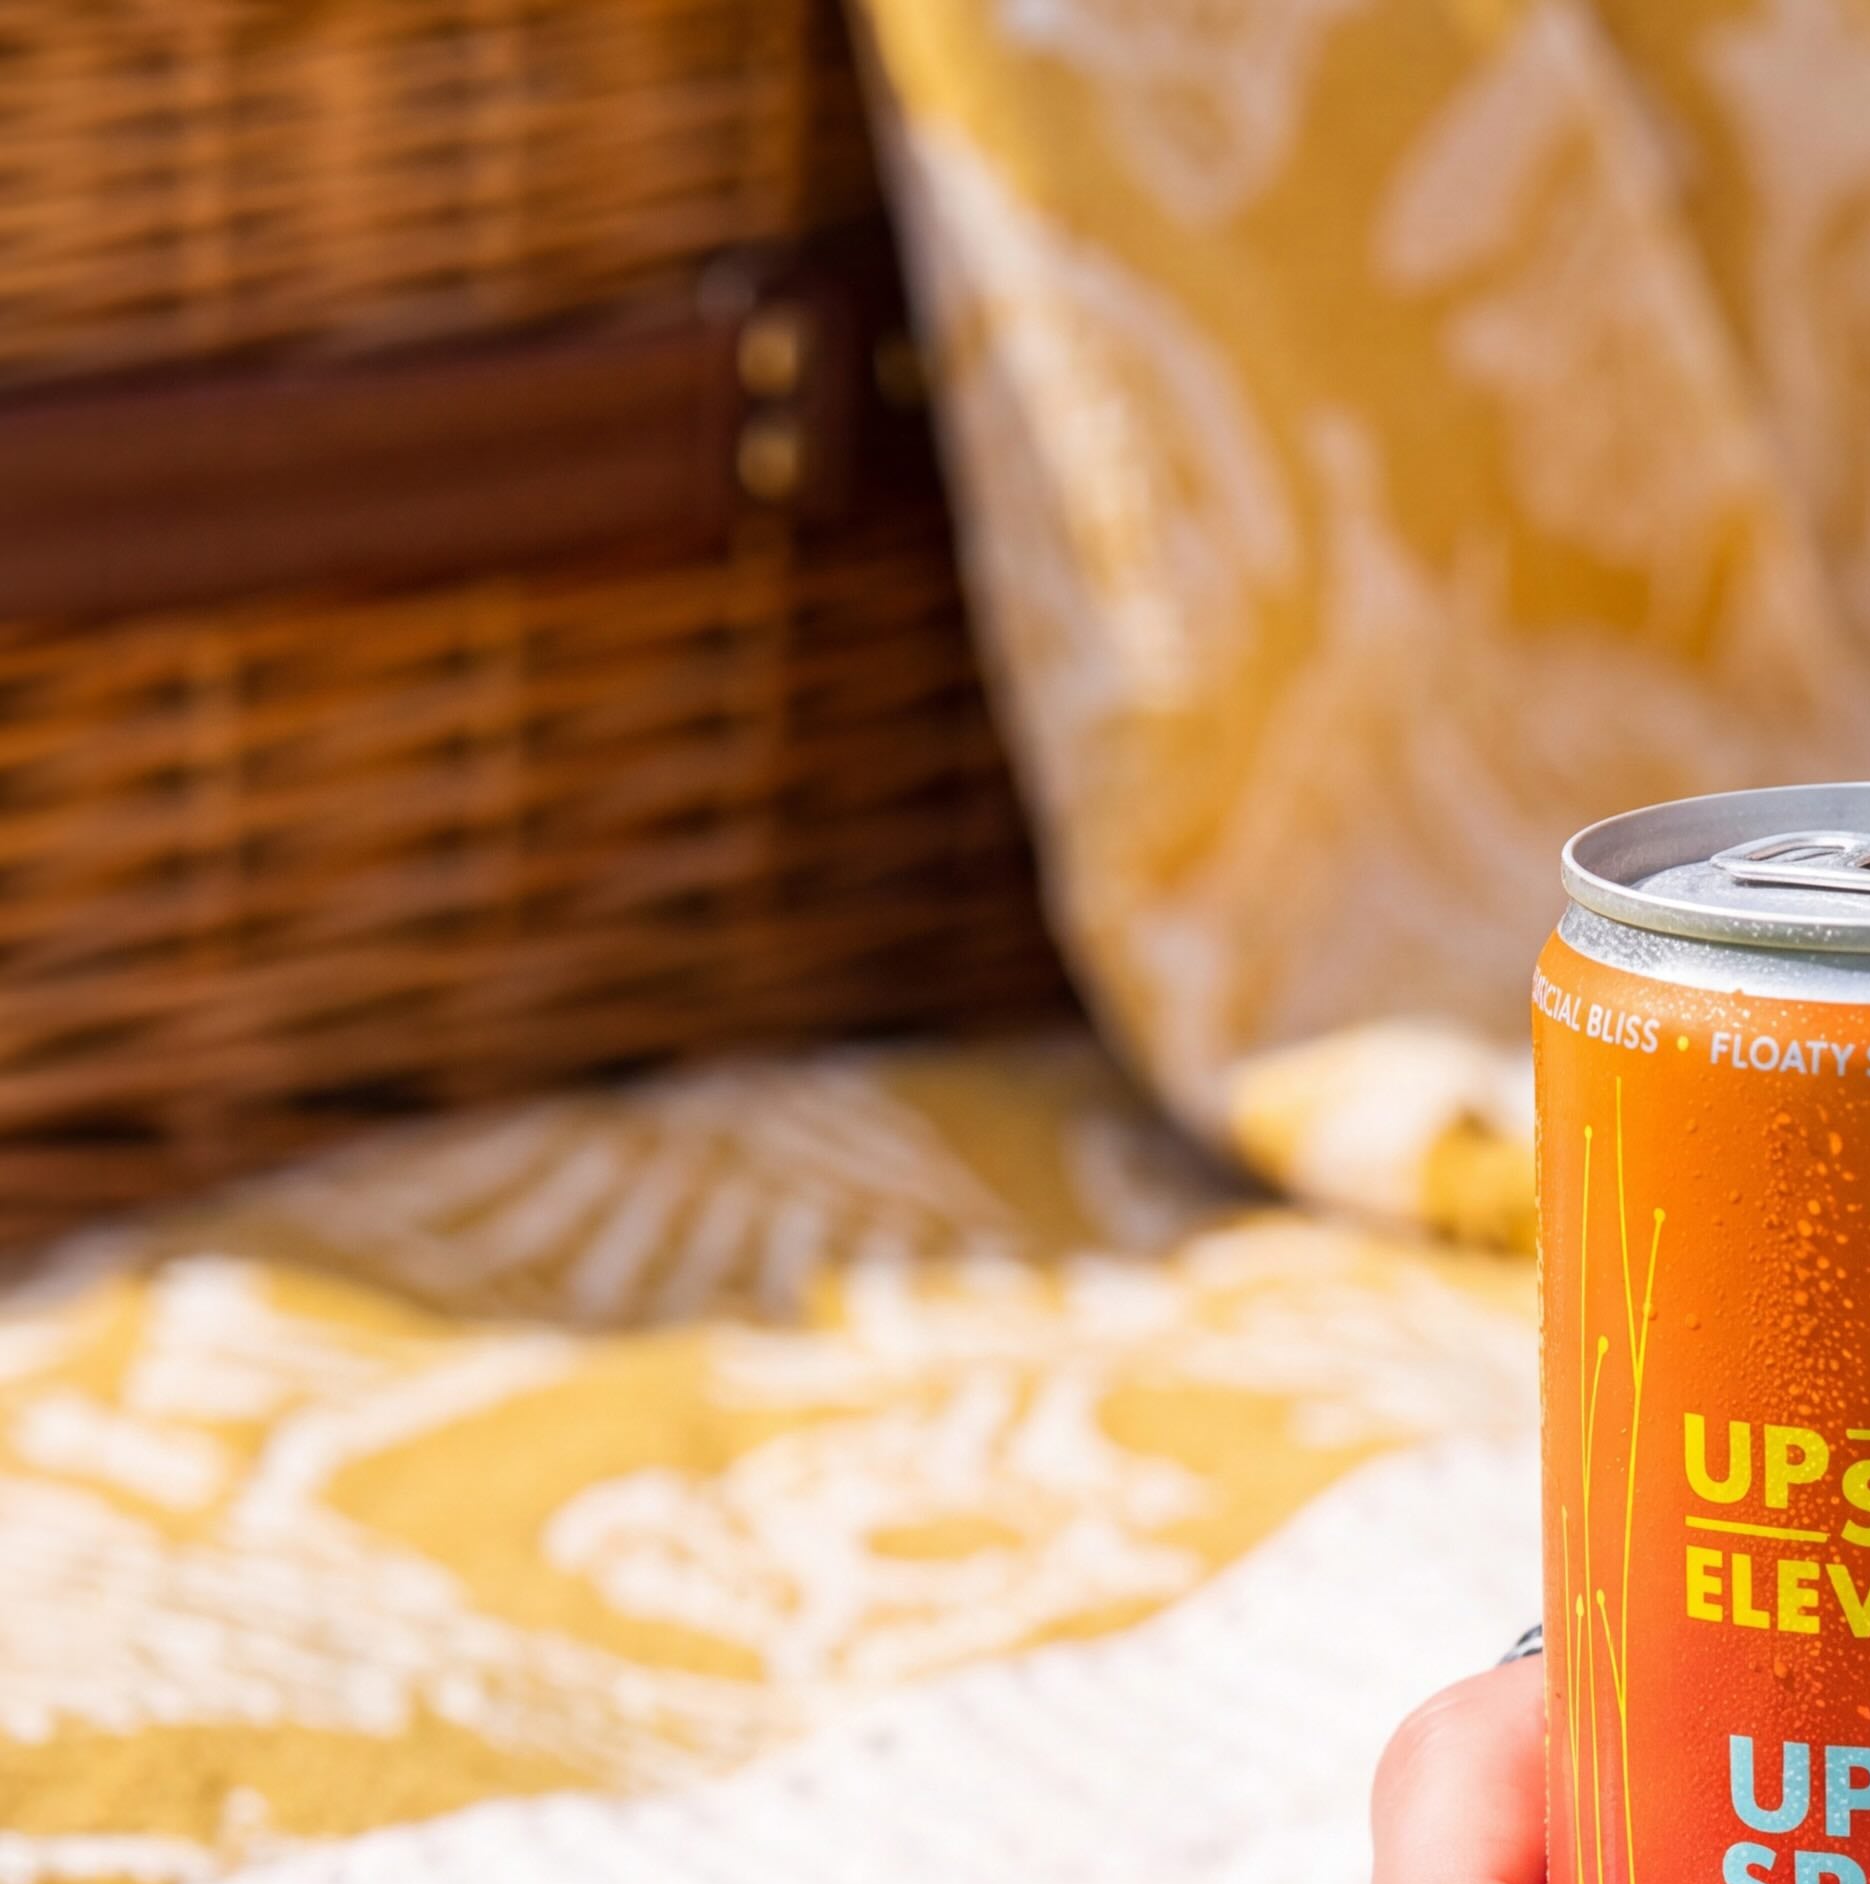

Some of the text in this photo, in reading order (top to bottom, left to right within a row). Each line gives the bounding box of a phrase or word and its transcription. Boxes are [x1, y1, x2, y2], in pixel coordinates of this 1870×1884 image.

[1532, 966, 1581, 1032] CIAL
[1586, 1003, 1661, 1054] BLISS
[1711, 1031, 1856, 1078] FLOATY
